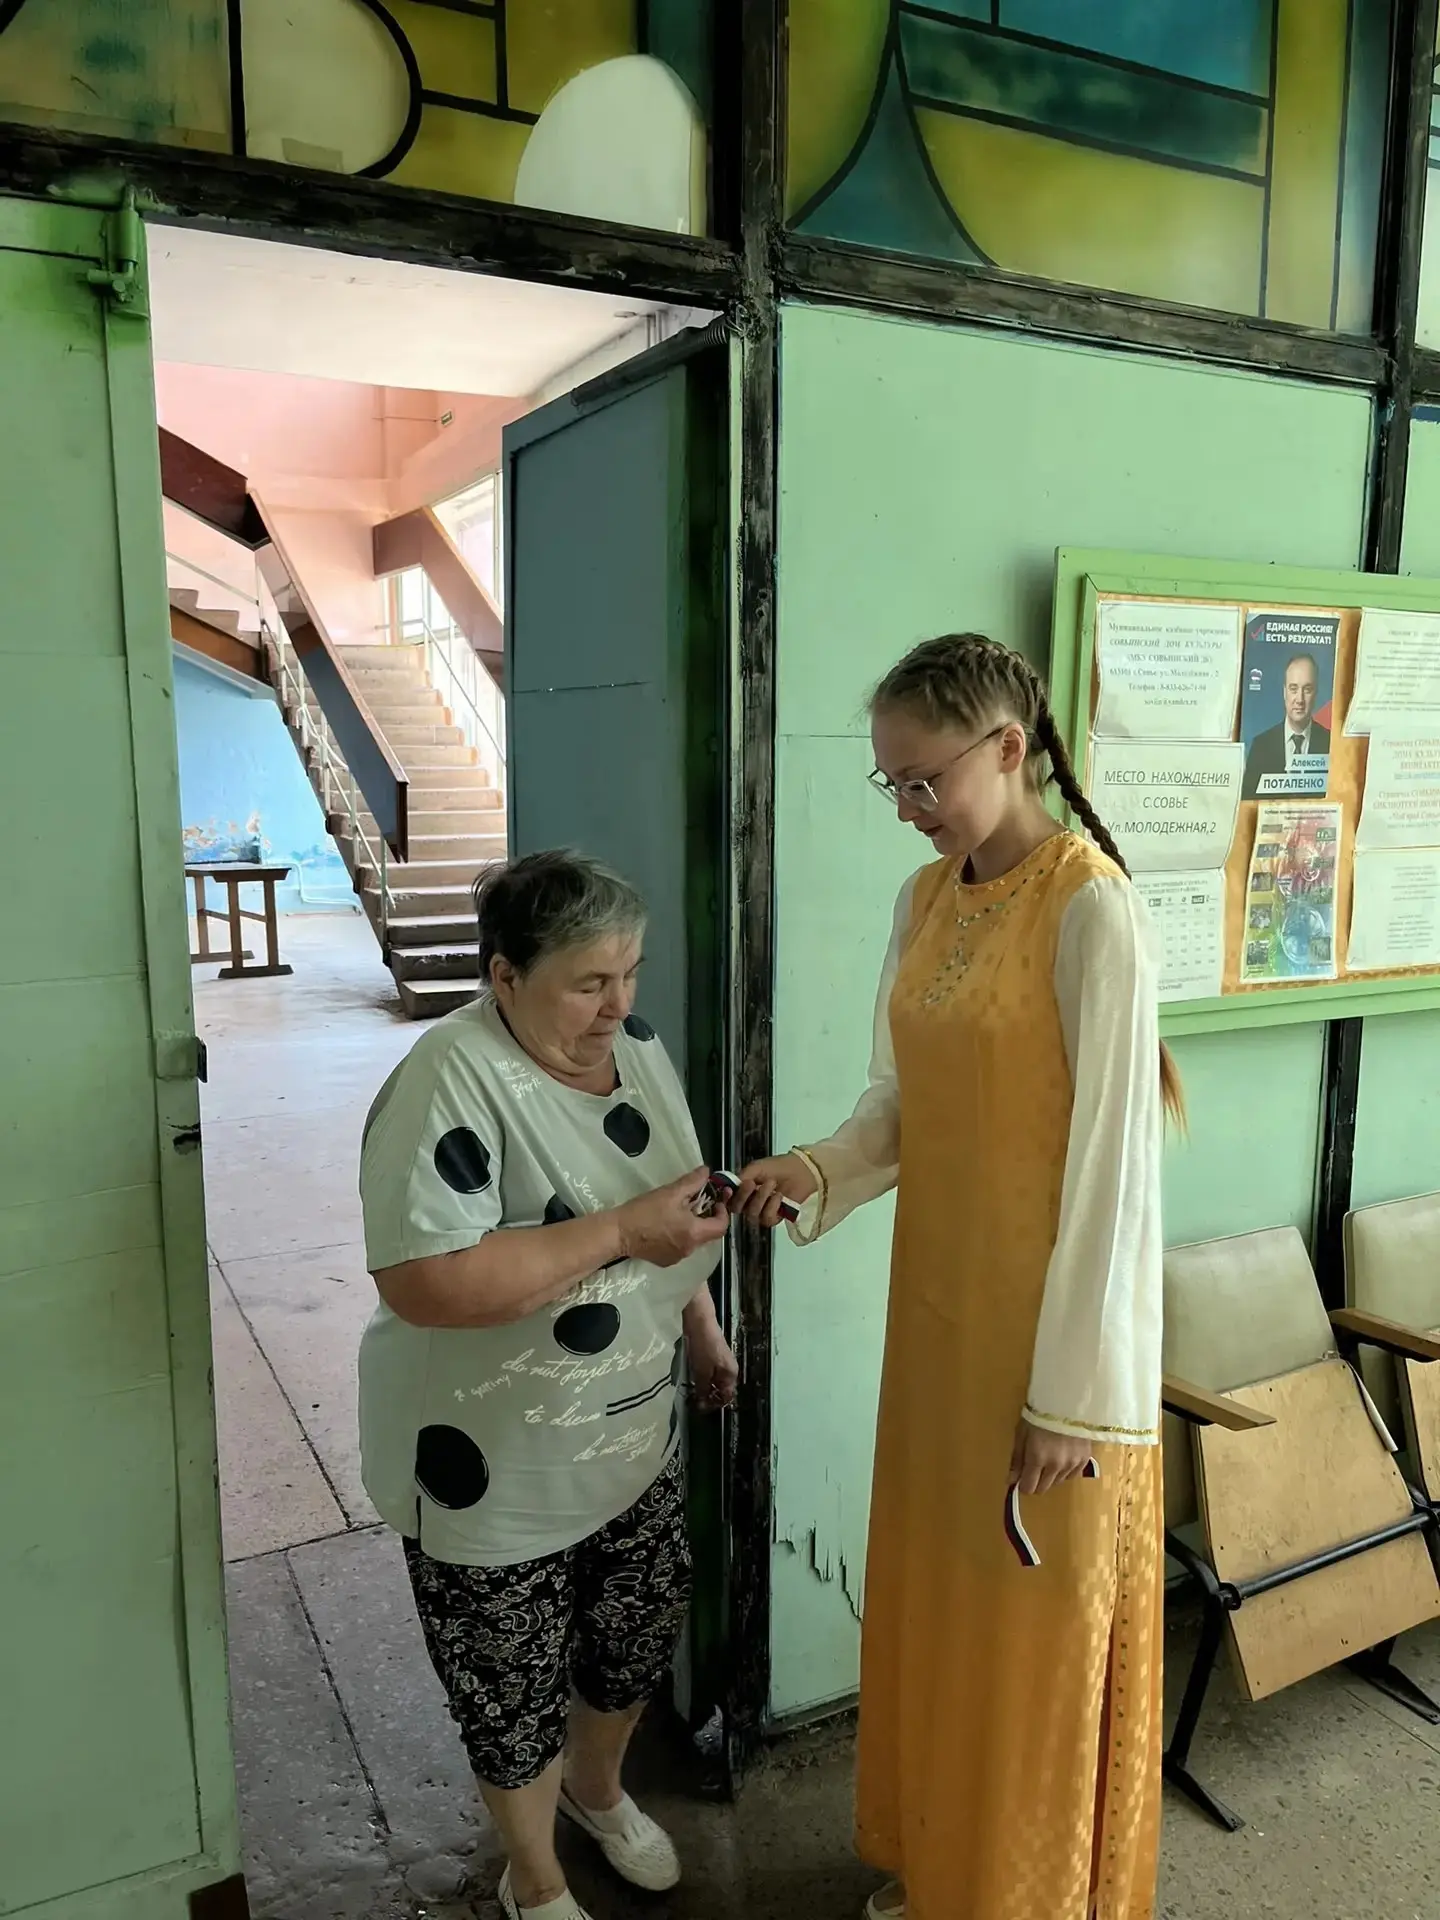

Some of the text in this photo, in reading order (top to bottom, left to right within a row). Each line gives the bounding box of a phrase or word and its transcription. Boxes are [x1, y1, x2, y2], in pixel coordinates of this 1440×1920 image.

[1266, 622, 1333, 633] ЕДИНАЯ РОССИЯ!
[1266, 634, 1332, 644] ЕСТЬ РЕЗУЛЬТАТ!
[1291, 758, 1326, 767] Алексей
[1104, 770, 1230, 786] МЕСТО НАХОЖДЕНИЯ
[1263, 778, 1324, 789] ПОТАПЕНКО
[1142, 796, 1189, 809] С.СОВЬЕ
